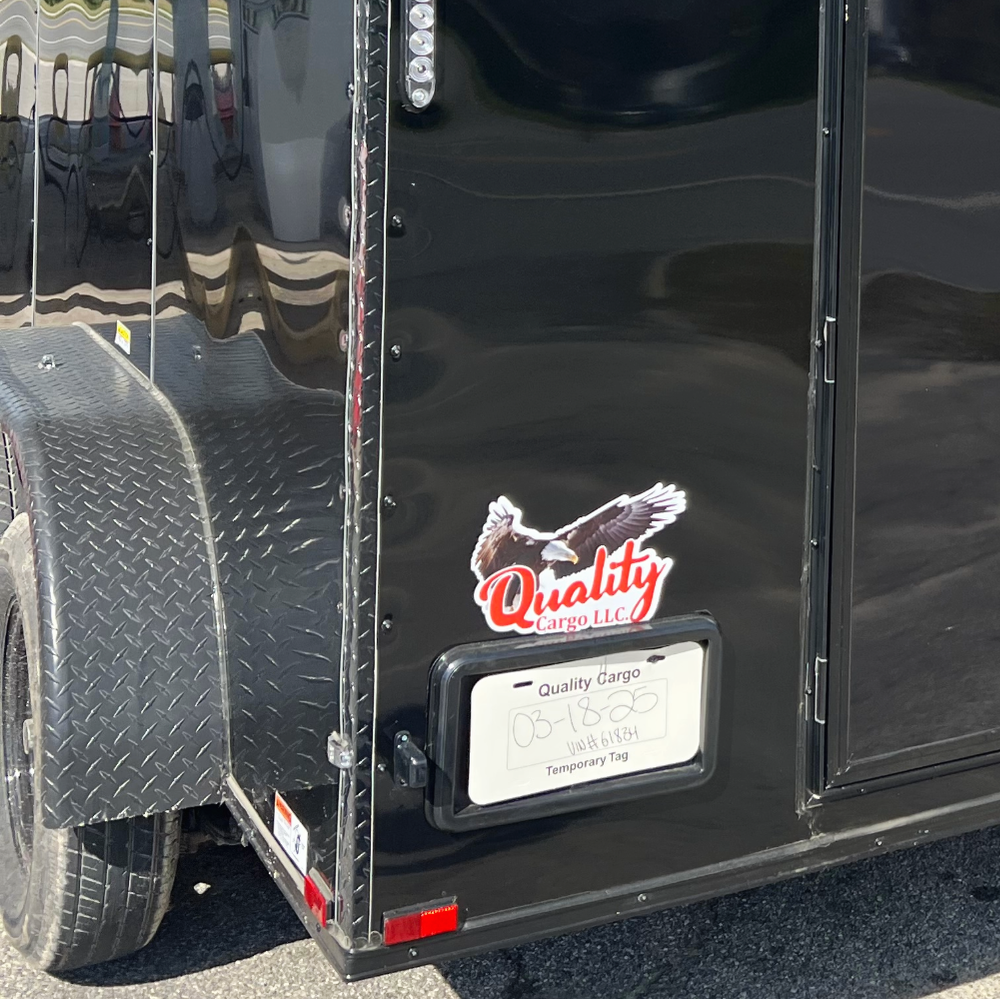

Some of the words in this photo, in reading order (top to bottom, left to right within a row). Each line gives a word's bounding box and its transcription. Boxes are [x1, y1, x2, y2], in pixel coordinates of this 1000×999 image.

[479, 540, 666, 629] Quality
[536, 612, 588, 633] Cargo
[538, 676, 592, 697] Quality
[597, 667, 641, 686] Cargo
[546, 755, 606, 776] Temporary
[608, 751, 629, 763] Tag
